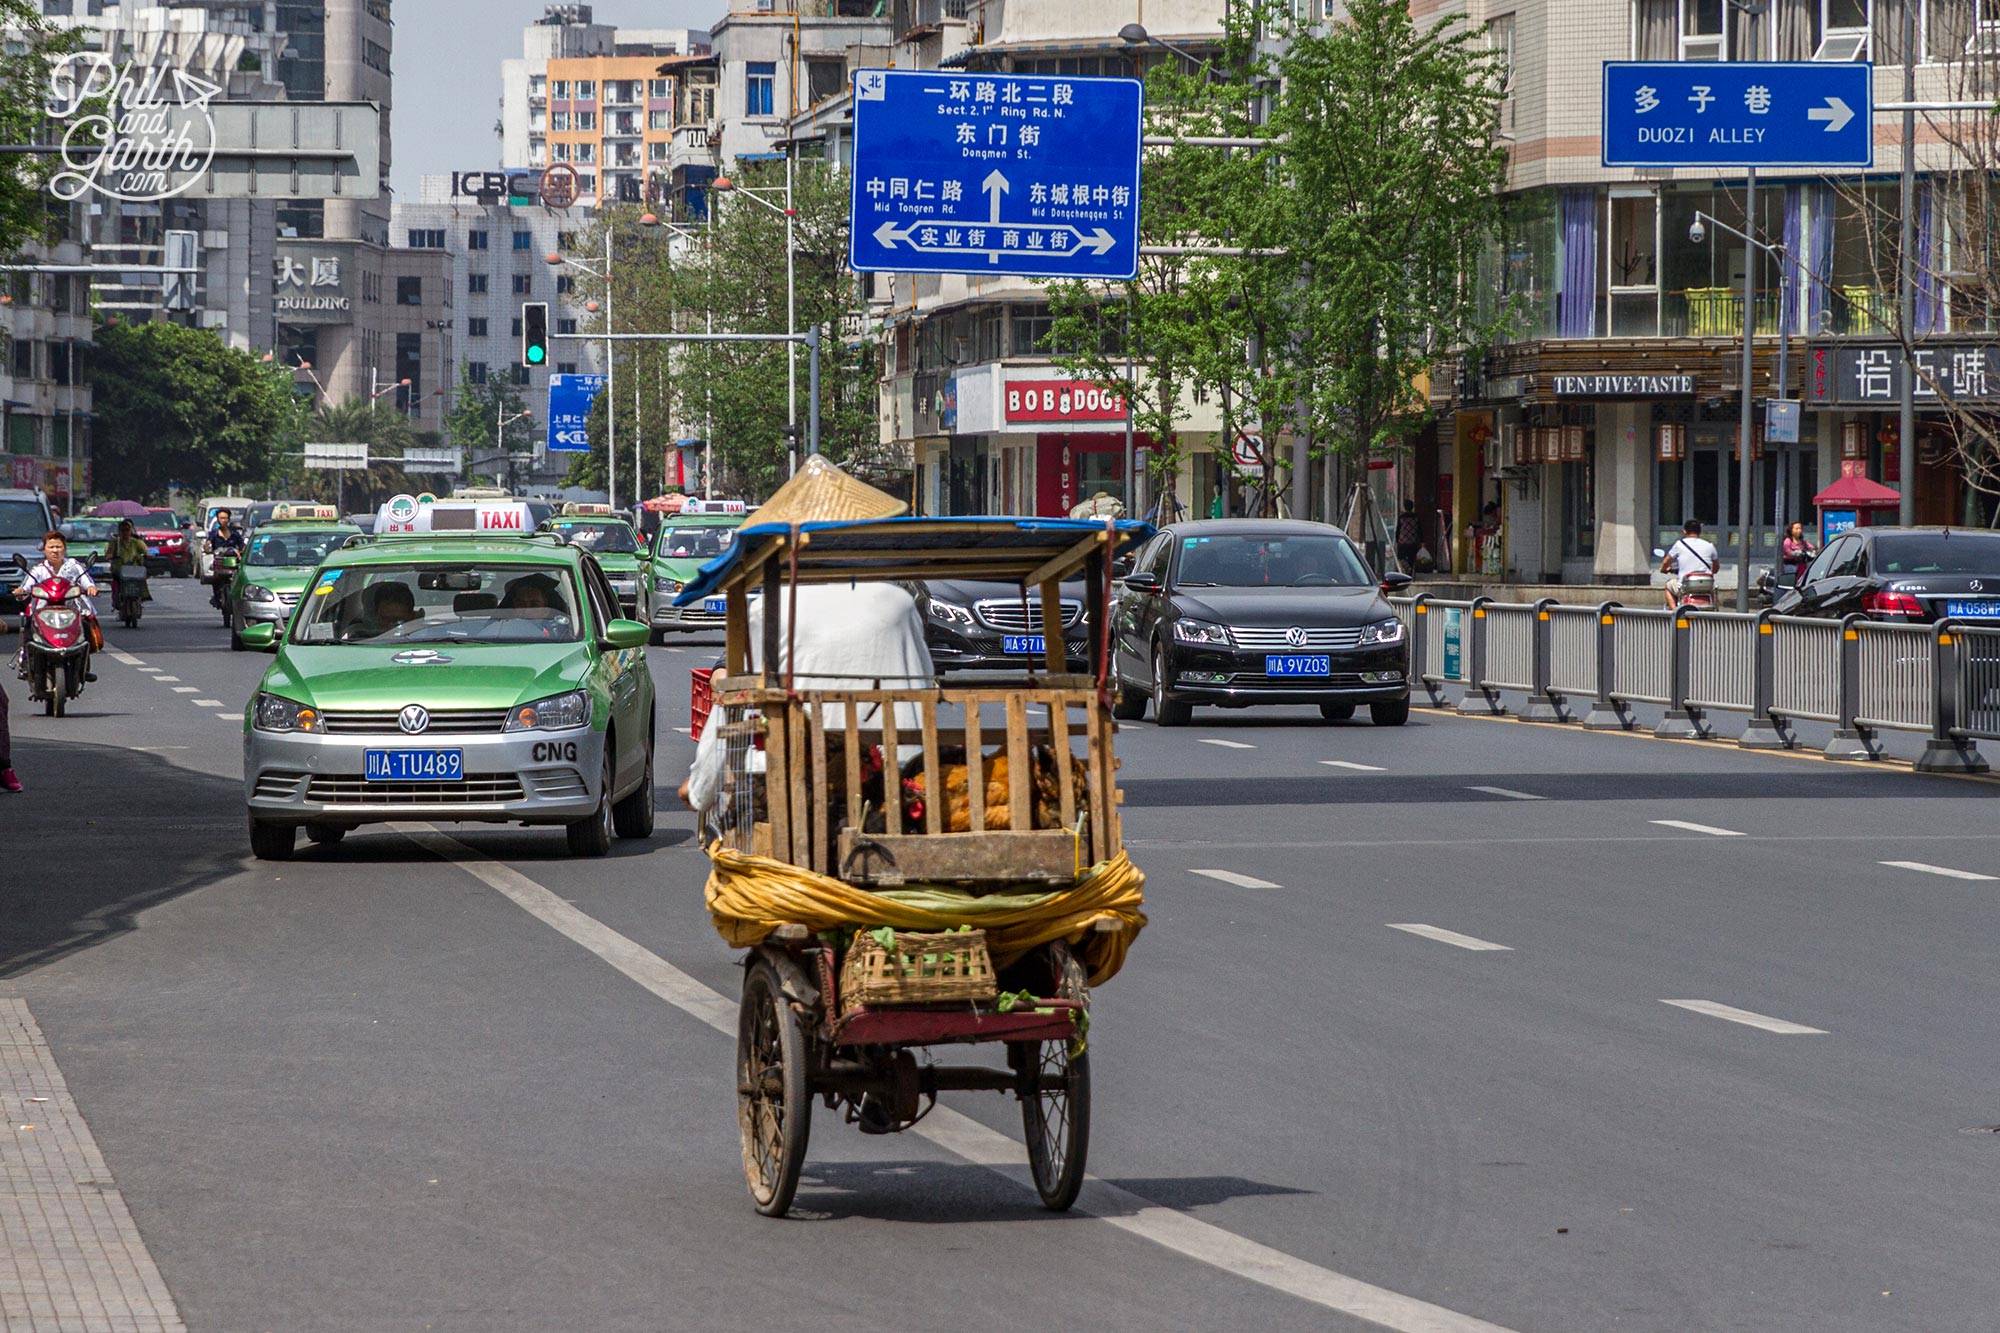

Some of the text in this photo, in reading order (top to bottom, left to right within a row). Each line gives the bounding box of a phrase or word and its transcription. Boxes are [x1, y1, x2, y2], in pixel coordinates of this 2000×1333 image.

[868, 75, 882, 88] 北
[924, 81, 1073, 105] 一环路北二段
[1635, 85, 1771, 114] 多子巷
[1001, 106, 1026, 119] Ring
[1033, 107, 1051, 118] Rd.
[956, 122, 1040, 146] 东门街
[1638, 127, 1766, 143] DUOZI ALLEY
[962, 147, 1032, 160] Dongmen St.
[452, 171, 535, 197] ICBC
[866, 177, 963, 201] 中同仁路
[1030, 182, 1130, 208] 东城根中街
[874, 202, 956, 215] Mid Tongren Rd.
[1032, 207, 1046, 217] Mid
[921, 227, 1068, 249] 实业街 商业街
[277, 256, 340, 287] 大厦
[279, 296, 349, 310] BUILDING
[1074, 389, 1113, 411] DOG
[1061, 473, 1070, 517] 巴布
[316, 509, 333, 518] TAXI
[726, 504, 743, 513] TAXI
[389, 523, 414, 532] 出租
[482, 511, 520, 529] TAXI
[532, 742, 577, 762] CNG
